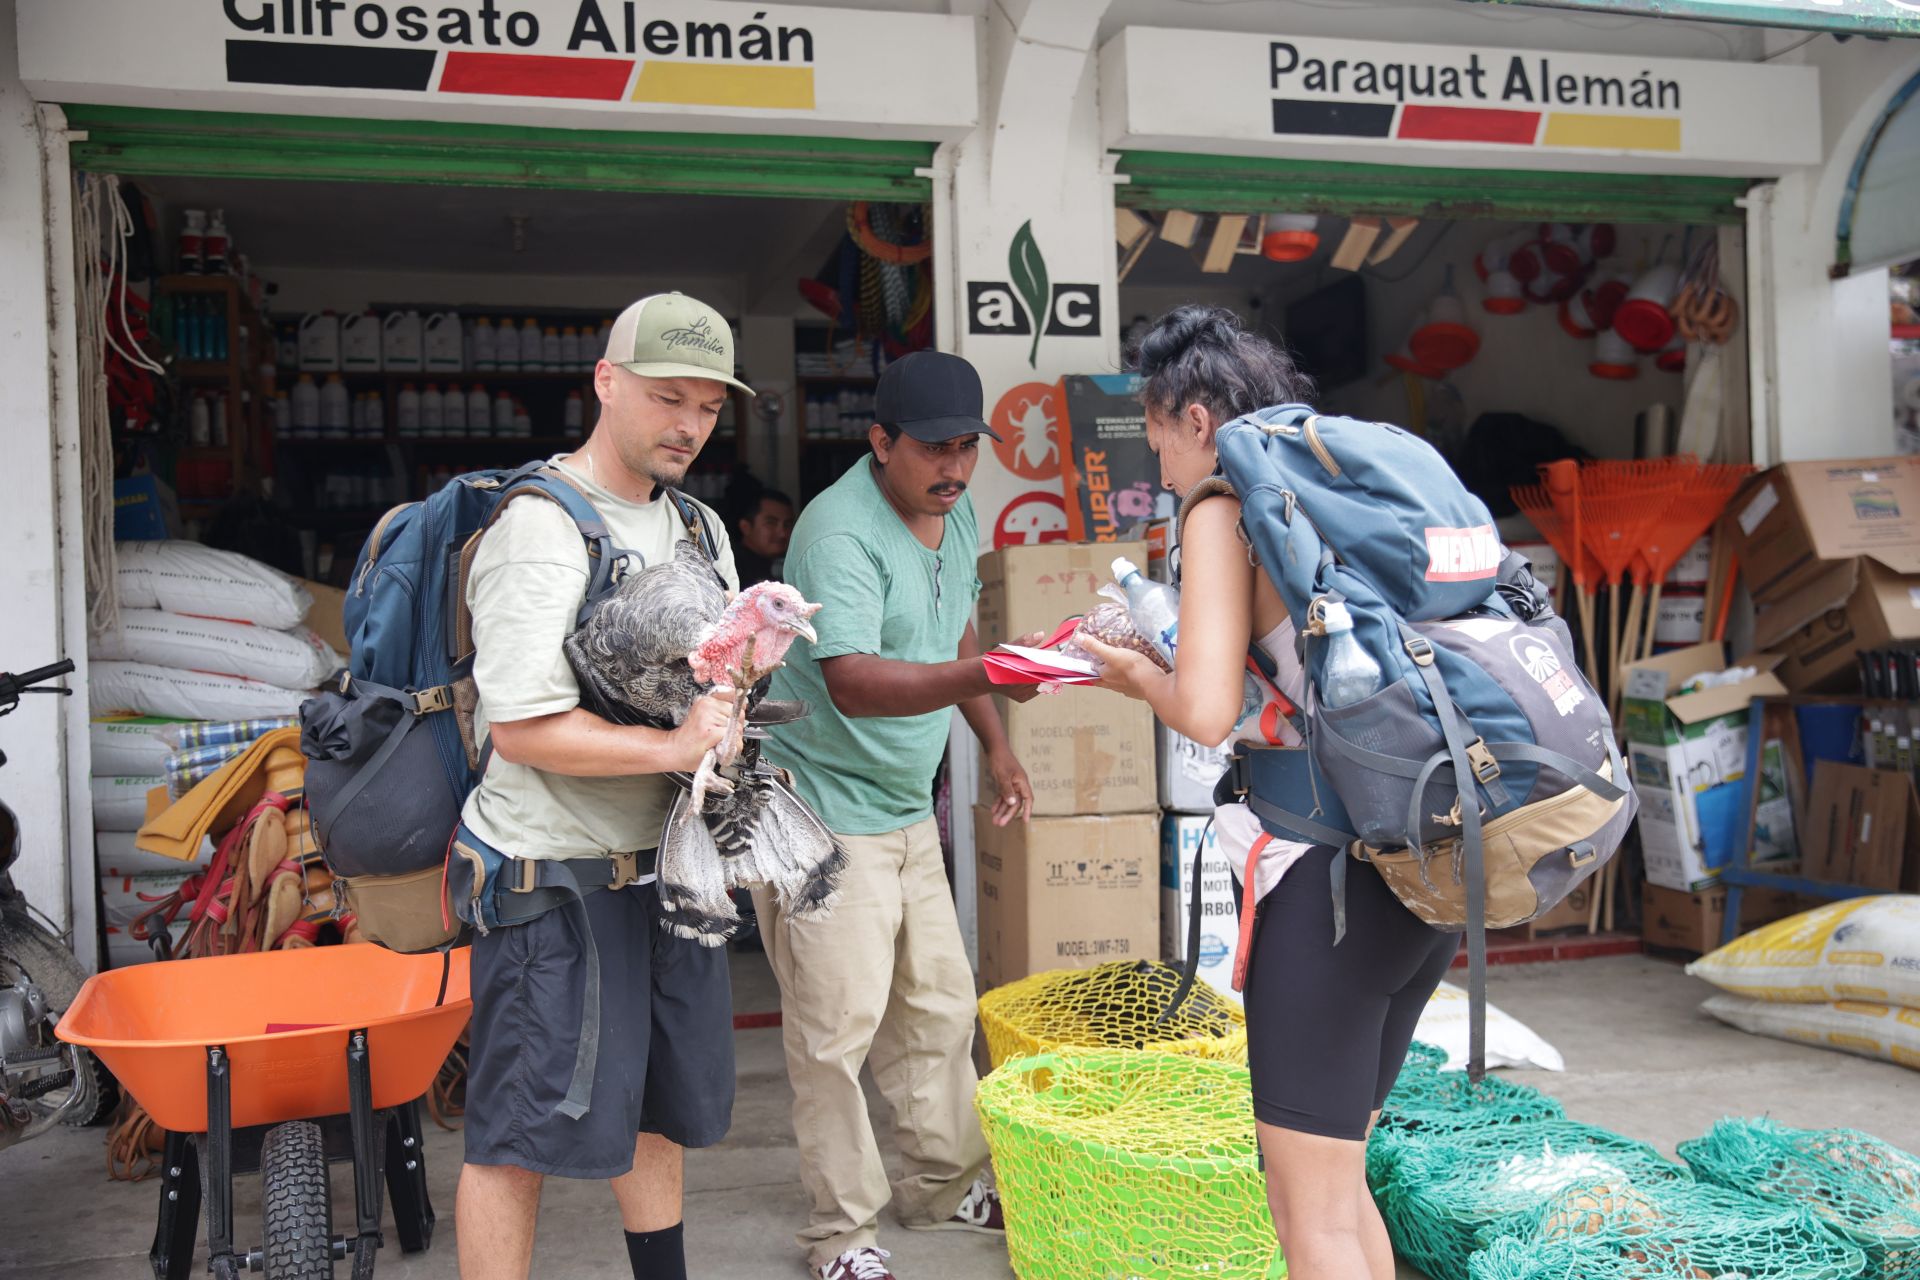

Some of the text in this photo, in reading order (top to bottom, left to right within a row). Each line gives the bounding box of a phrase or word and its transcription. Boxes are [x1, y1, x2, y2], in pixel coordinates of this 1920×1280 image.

[567, 0, 814, 62] Alemán
[1268, 42, 1681, 109] Paraquat Alemán
[689, 316, 712, 335] La
[661, 328, 725, 355] Familia
[1183, 828, 1217, 849] HY
[1185, 901, 1234, 917] TRBO
